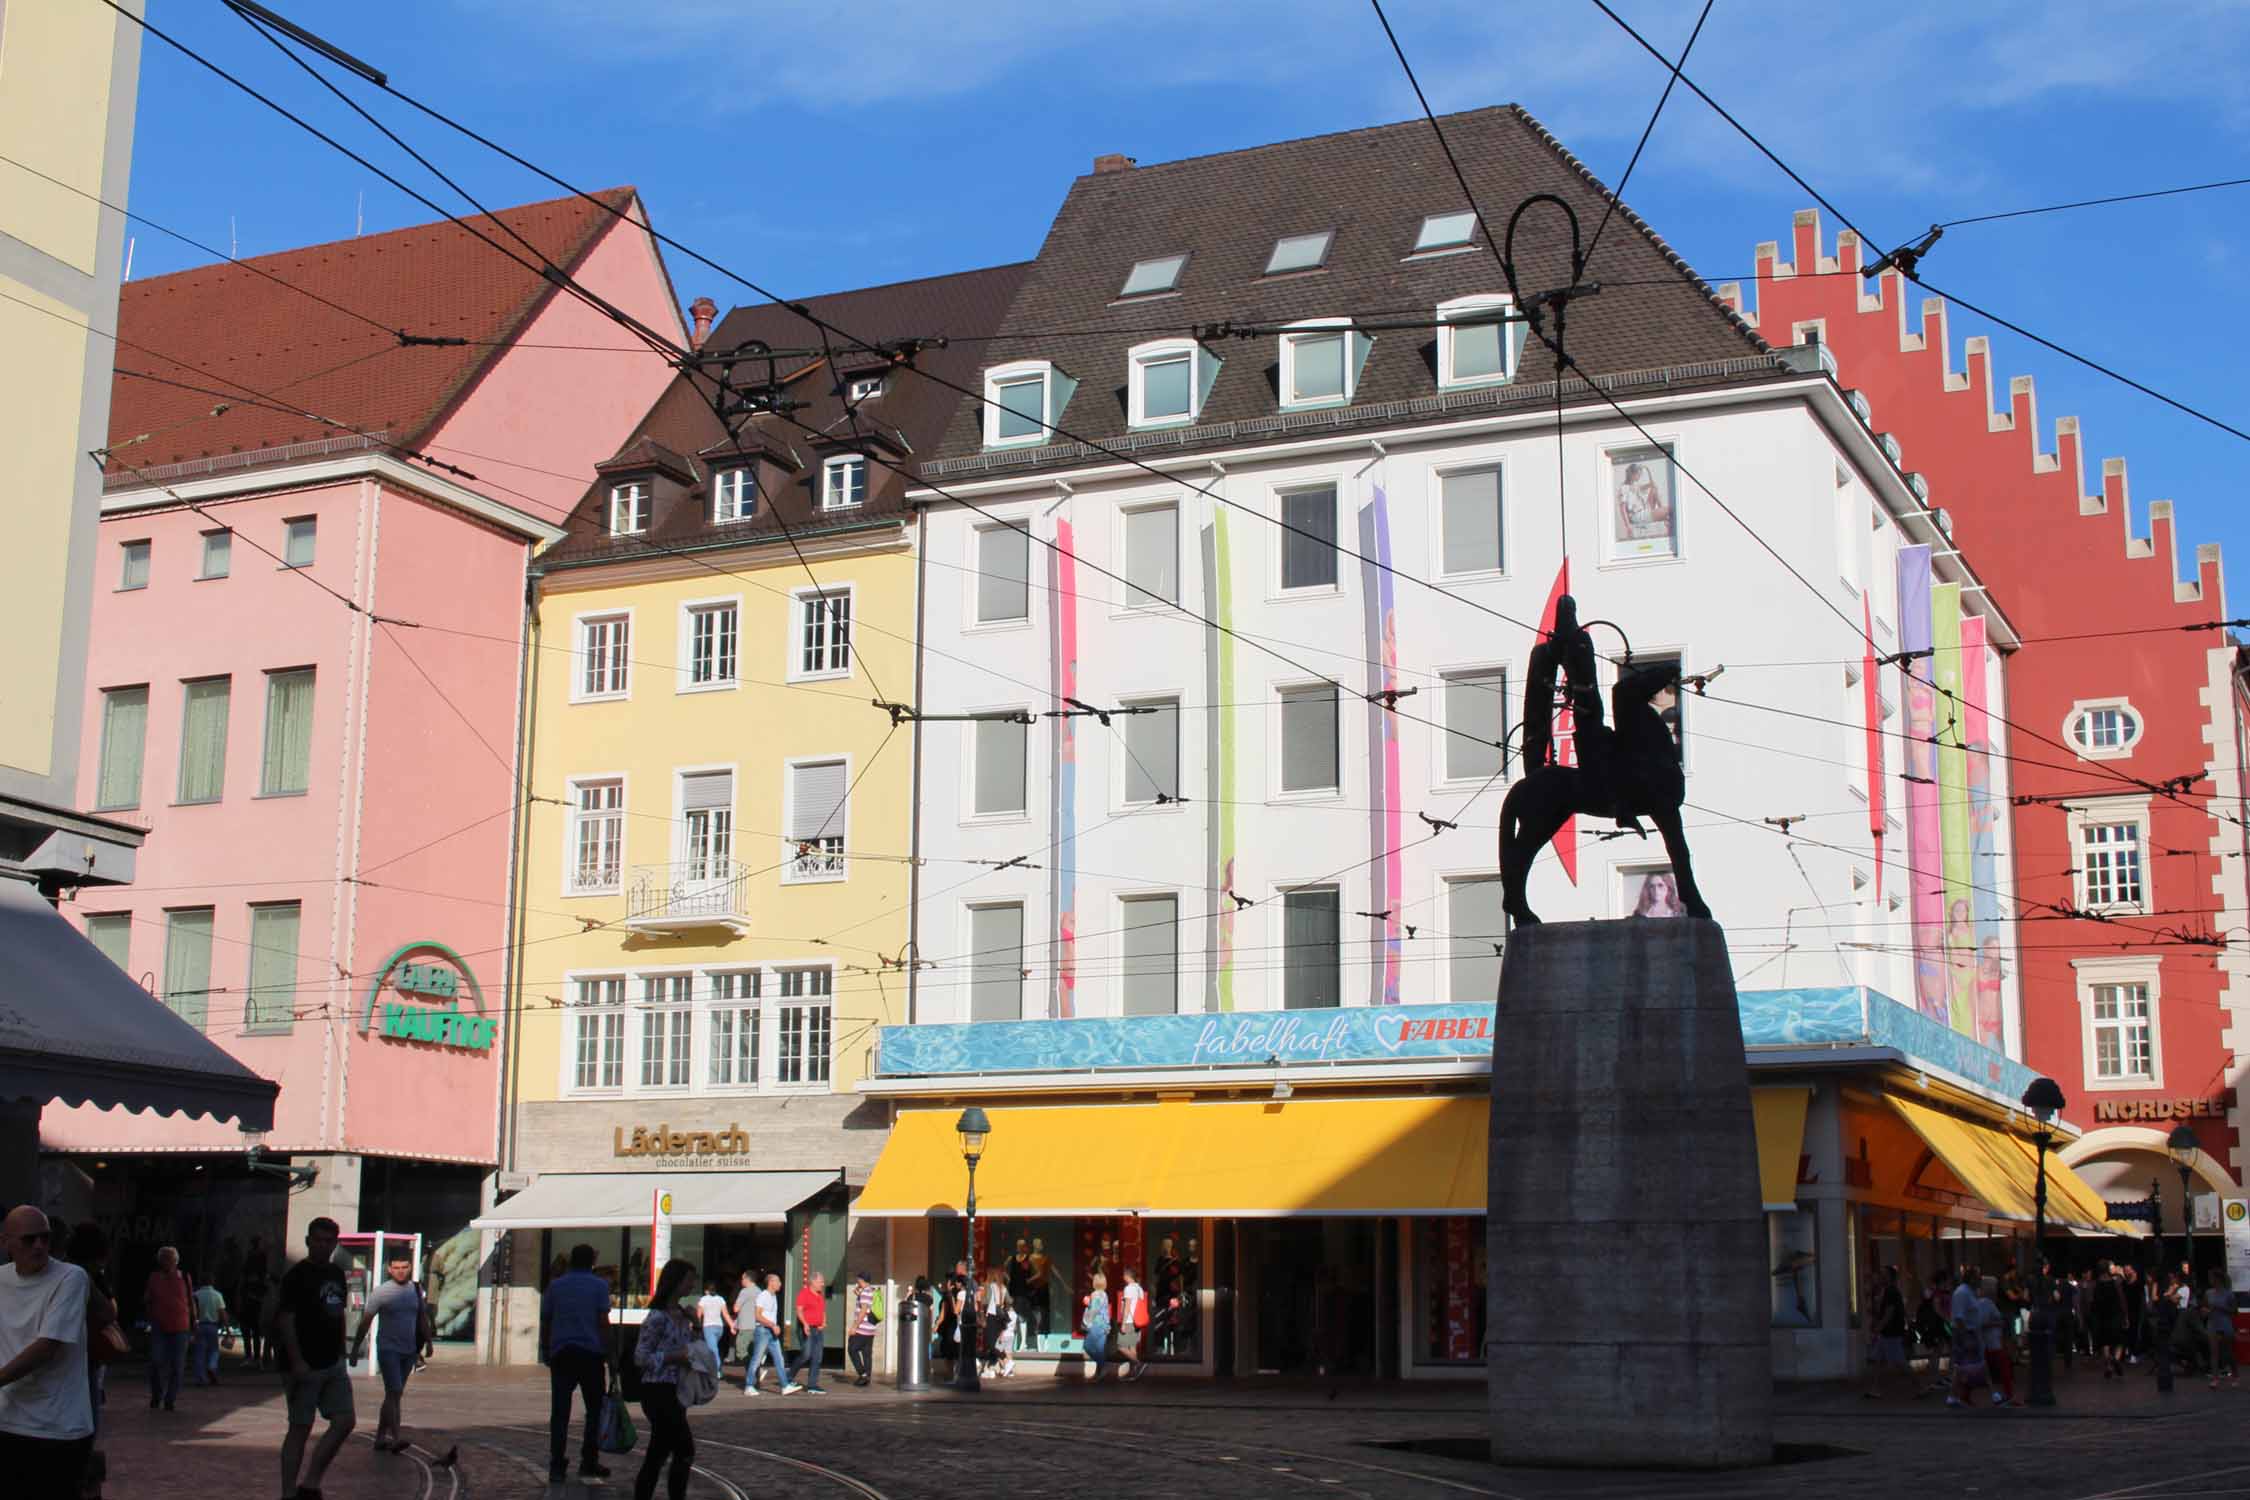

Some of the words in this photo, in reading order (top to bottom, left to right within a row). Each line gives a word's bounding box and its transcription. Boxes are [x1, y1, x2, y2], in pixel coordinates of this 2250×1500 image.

[1192, 1015, 1349, 1064] fabelhaft
[2096, 1098, 2226, 1121] NORDSEE
[614, 1121, 750, 1156] Läderach
[656, 1156, 714, 1168] chocolatier
[716, 1156, 751, 1167] suisse
